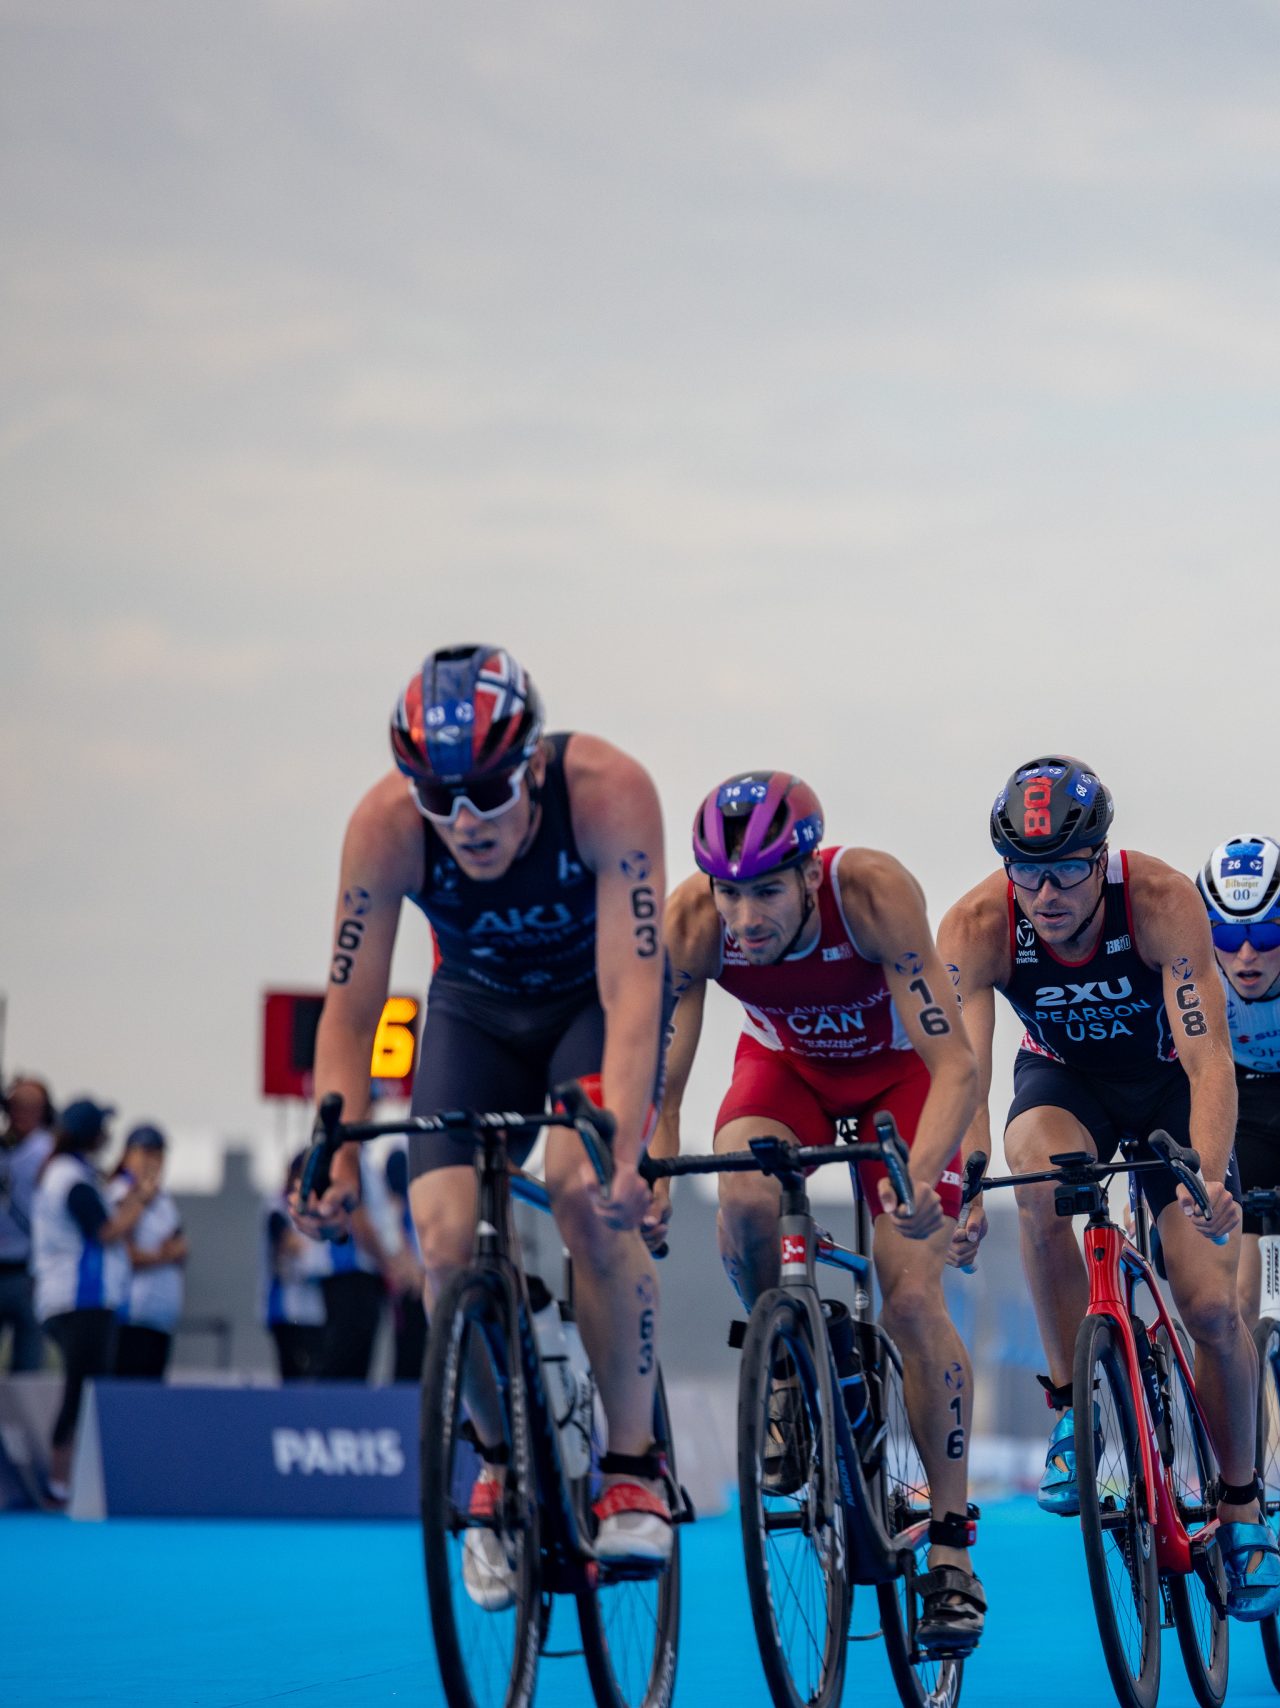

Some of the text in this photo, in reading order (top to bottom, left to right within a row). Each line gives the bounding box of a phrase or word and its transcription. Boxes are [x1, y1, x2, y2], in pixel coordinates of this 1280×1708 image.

[426, 706, 446, 726] 63
[726, 786, 741, 797] 16
[1227, 860, 1241, 870] 26
[630, 886, 658, 959] 63
[329, 919, 364, 986] 63
[1018, 949, 1036, 957] World
[1035, 976, 1133, 1007] 2XU
[909, 977, 951, 1038] 16
[1035, 999, 1152, 1024] PEARSON
[787, 1010, 865, 1035] CAN
[1065, 1018, 1134, 1042] USA
[946, 1396, 965, 1459] 16
[272, 1428, 405, 1476] PARIS
